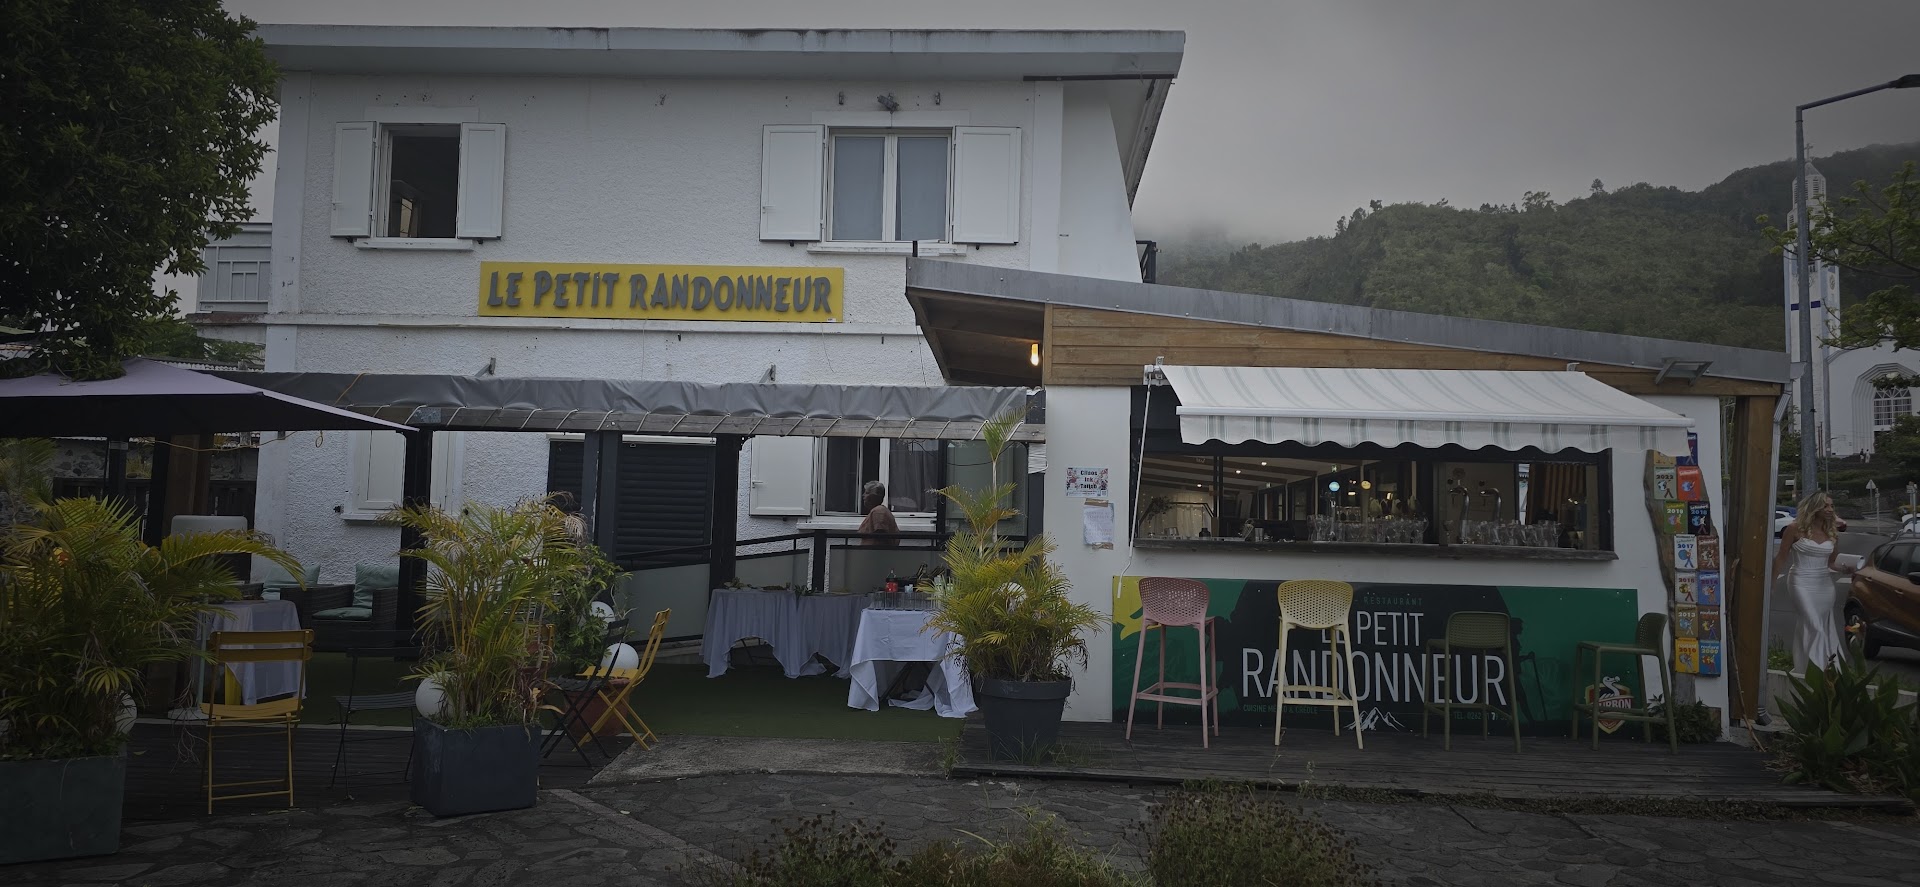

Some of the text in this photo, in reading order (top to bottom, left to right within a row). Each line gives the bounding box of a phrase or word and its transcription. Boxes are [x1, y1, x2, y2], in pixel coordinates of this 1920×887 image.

[486, 270, 833, 314] LE PETIT RANDONNEUR
[1362, 596, 1424, 606] RESTAURANT
[1356, 611, 1424, 646] PETIT
[1242, 648, 1507, 706] RANDONNEUR
[1242, 704, 1267, 713] CUISINE
